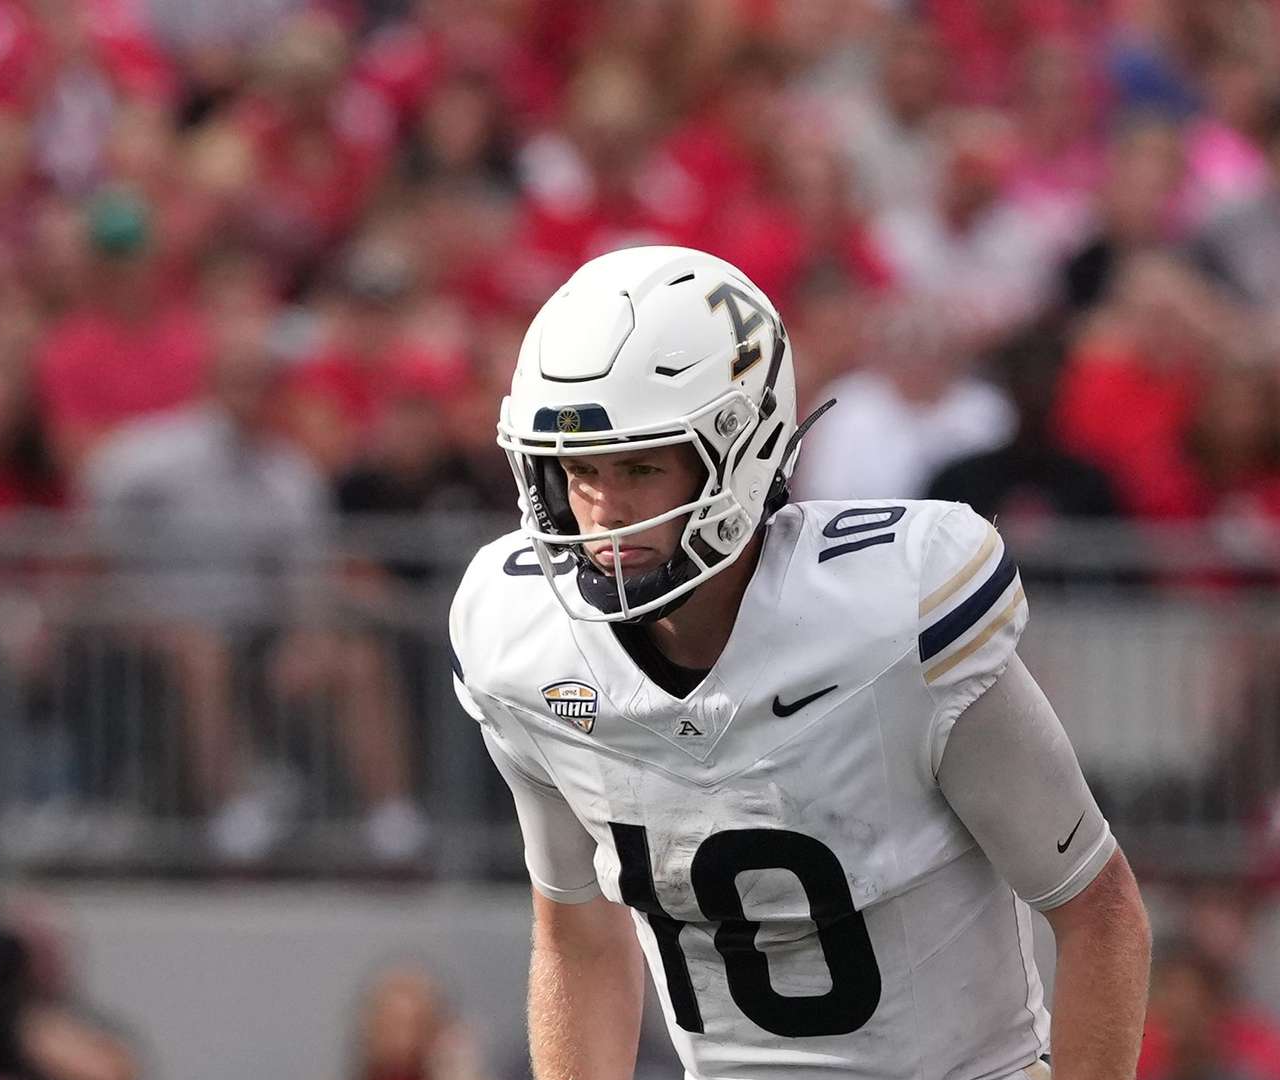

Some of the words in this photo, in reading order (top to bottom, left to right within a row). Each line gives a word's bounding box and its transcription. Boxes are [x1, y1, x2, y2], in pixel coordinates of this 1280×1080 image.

[705, 281, 782, 382] A
[819, 506, 907, 563] 10
[550, 700, 598, 718] MAC
[679, 721, 702, 735] A
[608, 821, 883, 1038] 10
